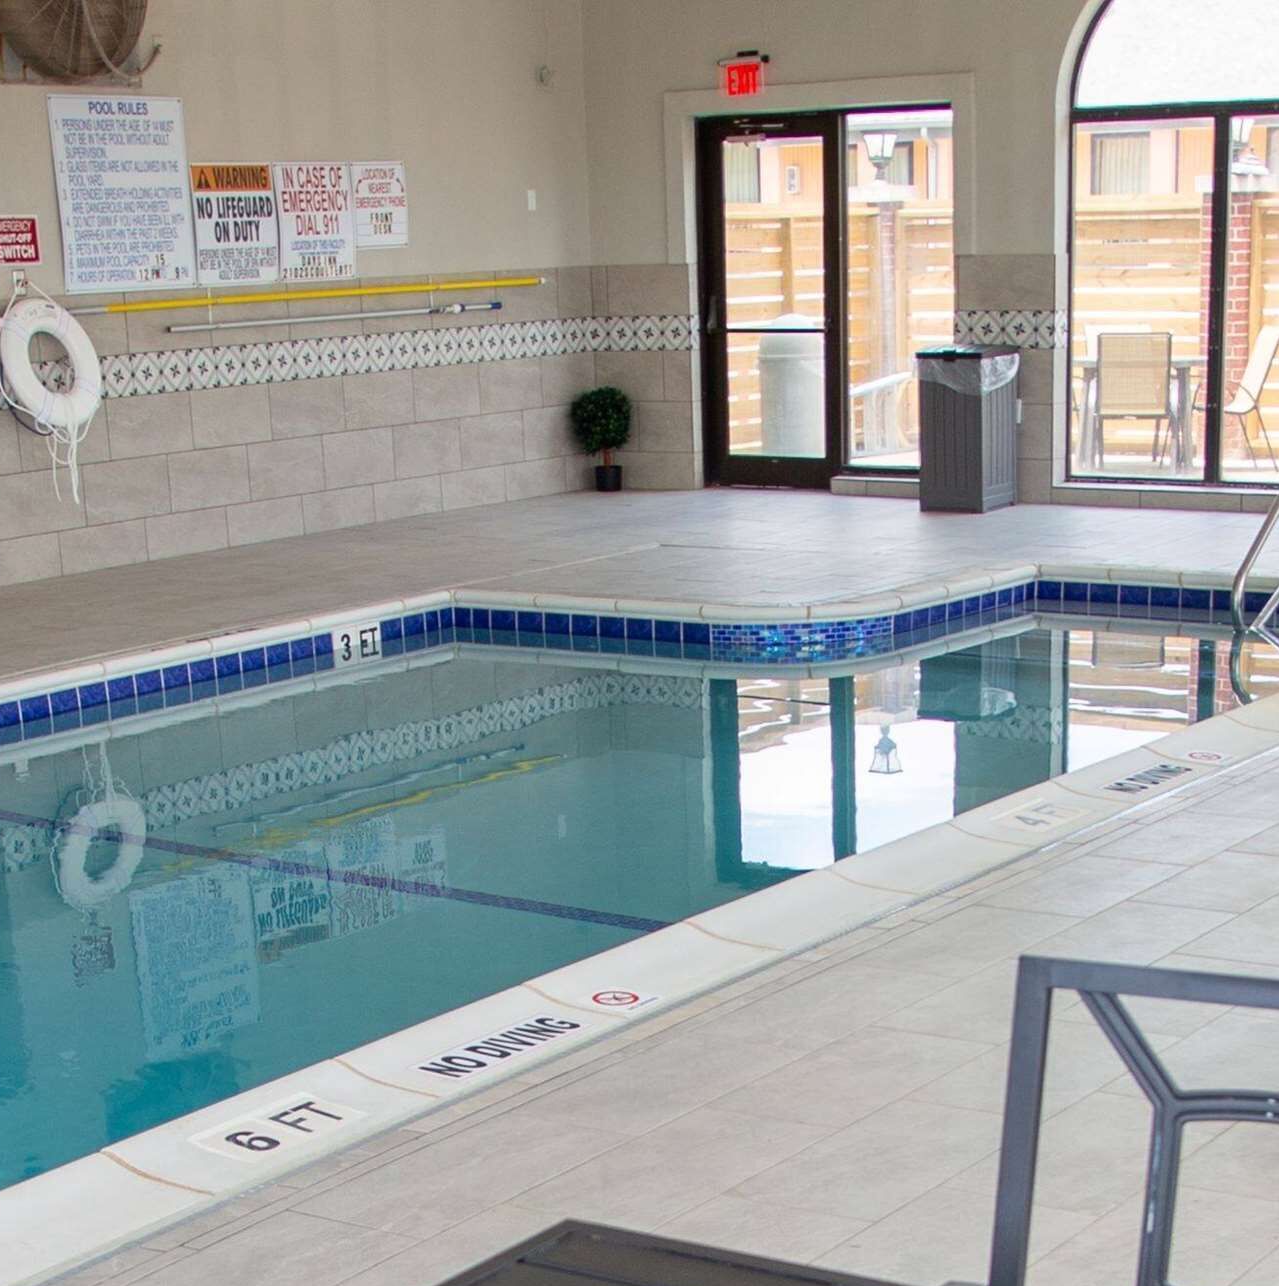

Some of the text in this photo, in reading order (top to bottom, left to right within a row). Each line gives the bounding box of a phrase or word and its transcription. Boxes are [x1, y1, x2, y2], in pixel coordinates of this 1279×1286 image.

[727, 64, 759, 96] EXIT
[88, 101, 149, 116] POOL RULES
[62, 118, 92, 131] PERSONS
[94, 118, 114, 131] UNDER
[115, 119, 127, 131] THE
[129, 119, 140, 131] AGE
[143, 119, 150, 131] OF
[158, 120, 174, 131] MUST
[64, 133, 169, 145] NOT BE IN THE POOL WITHOUT ADULT
[67, 160, 86, 173] GLASS
[106, 160, 119, 172] ARE
[120, 160, 132, 172] NOT
[134, 160, 160, 172] ALLOWED
[167, 160, 178, 172] THE
[213, 166, 268, 189] WARNING
[282, 167, 342, 189] IN CASE OF
[361, 167, 395, 180] LOCATION OF
[68, 174, 85, 187] POOL
[71, 187, 102, 200] EXTENDED
[368, 182, 391, 193] NEAREST
[72, 201, 83, 213] ARE
[84, 201, 121, 213] DANGEROUS
[196, 195, 273, 219] NO LIFEGUARD
[281, 190, 348, 212] EMERGENCY
[355, 196, 406, 208] EMERGENCY PHONE
[370, 212, 392, 223] FRONT
[296, 214, 340, 235] DIAL 911
[374, 224, 392, 234] DESK
[214, 220, 261, 243] ON DUTY
[99, 243, 110, 254] THE
[111, 242, 128, 254] POOL
[77, 256, 105, 268] MAXIMUM
[106, 256, 121, 267] POOL
[155, 253, 166, 267] 15
[302, 255, 321, 267] DAYS
[78, 271, 98, 283] HOURS
[139, 267, 149, 281] 12
[1015, 815, 1051, 826] 4
[418, 1017, 581, 1078] NO DIVING
[225, 1101, 343, 1152] 6 FT
